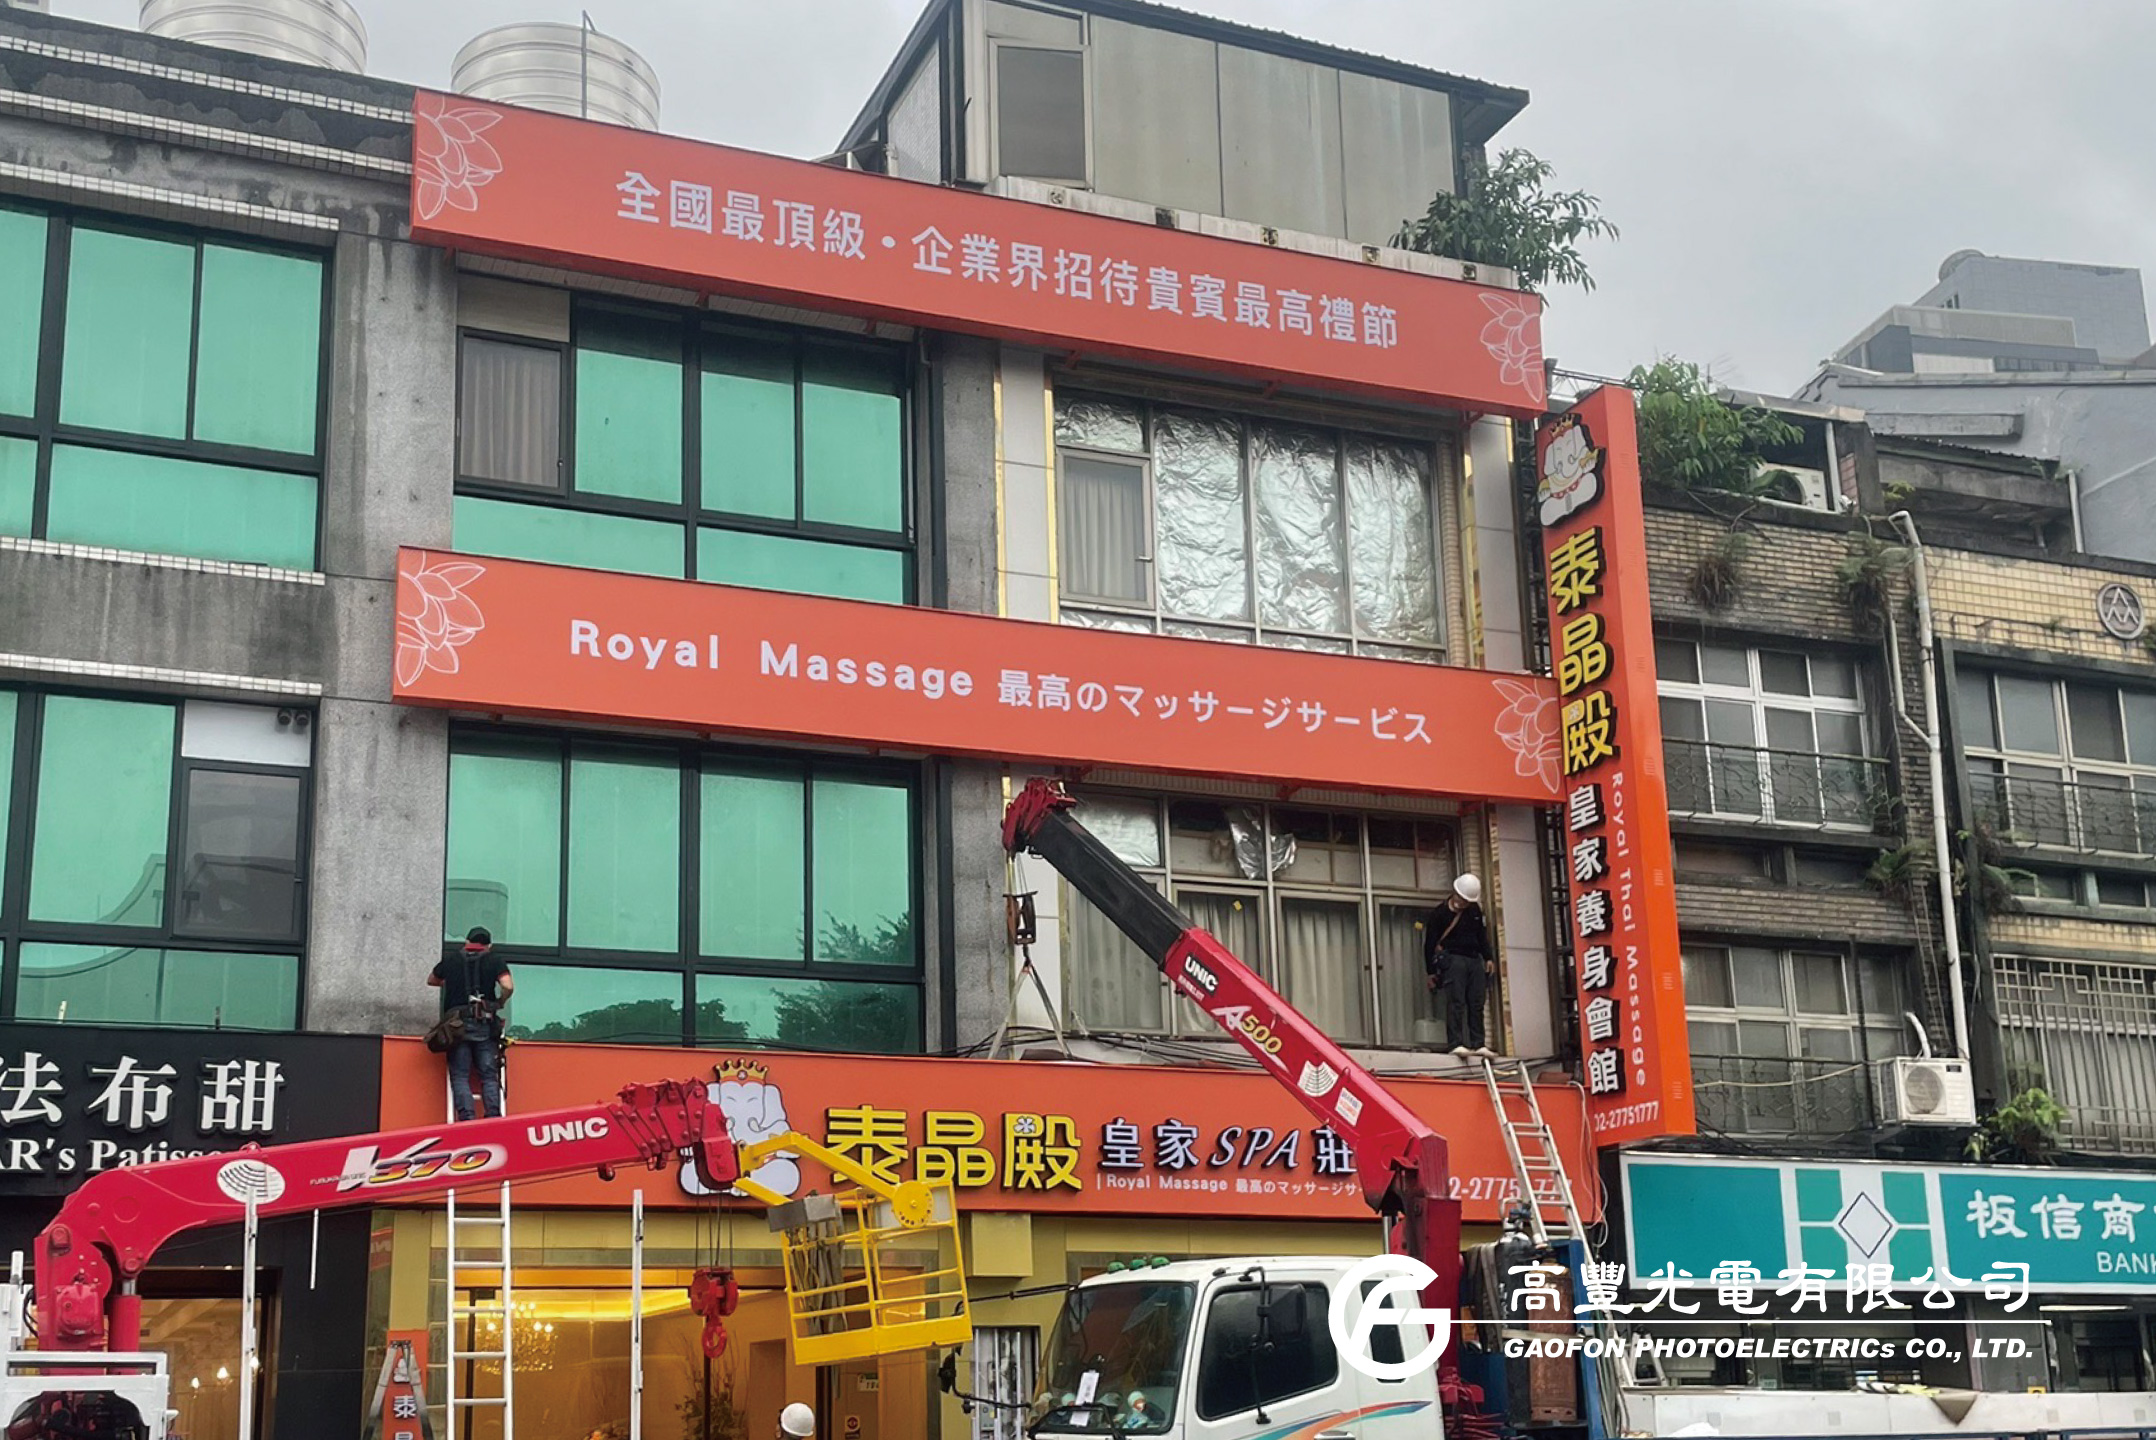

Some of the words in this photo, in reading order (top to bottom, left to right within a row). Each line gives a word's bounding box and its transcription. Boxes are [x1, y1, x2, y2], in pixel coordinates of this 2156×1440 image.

[570, 619, 719, 670] Royal
[760, 640, 973, 699] Massage
[997, 668, 1432, 744] 最高のマッサージサービス
[1550, 527, 1614, 776] 泰晶殿
[1568, 785, 1619, 1096] 皇家養身會館
[1612, 771, 1630, 857] Royal
[1625, 945, 1646, 1086] Massage
[1185, 955, 1219, 991] UNIC
[0, 1051, 285, 1132] 法布甜
[527, 1117, 609, 1146] UNIC
[0, 1137, 76, 1171] R's
[827, 1105, 1082, 1189] 泰晶殿
[1106, 1173, 1150, 1189] Royal
[1159, 1175, 1228, 1193] Massage
[1236, 1178, 1363, 1196] 最高のマッサージサ
[1966, 1189, 2156, 1243] 板信商
